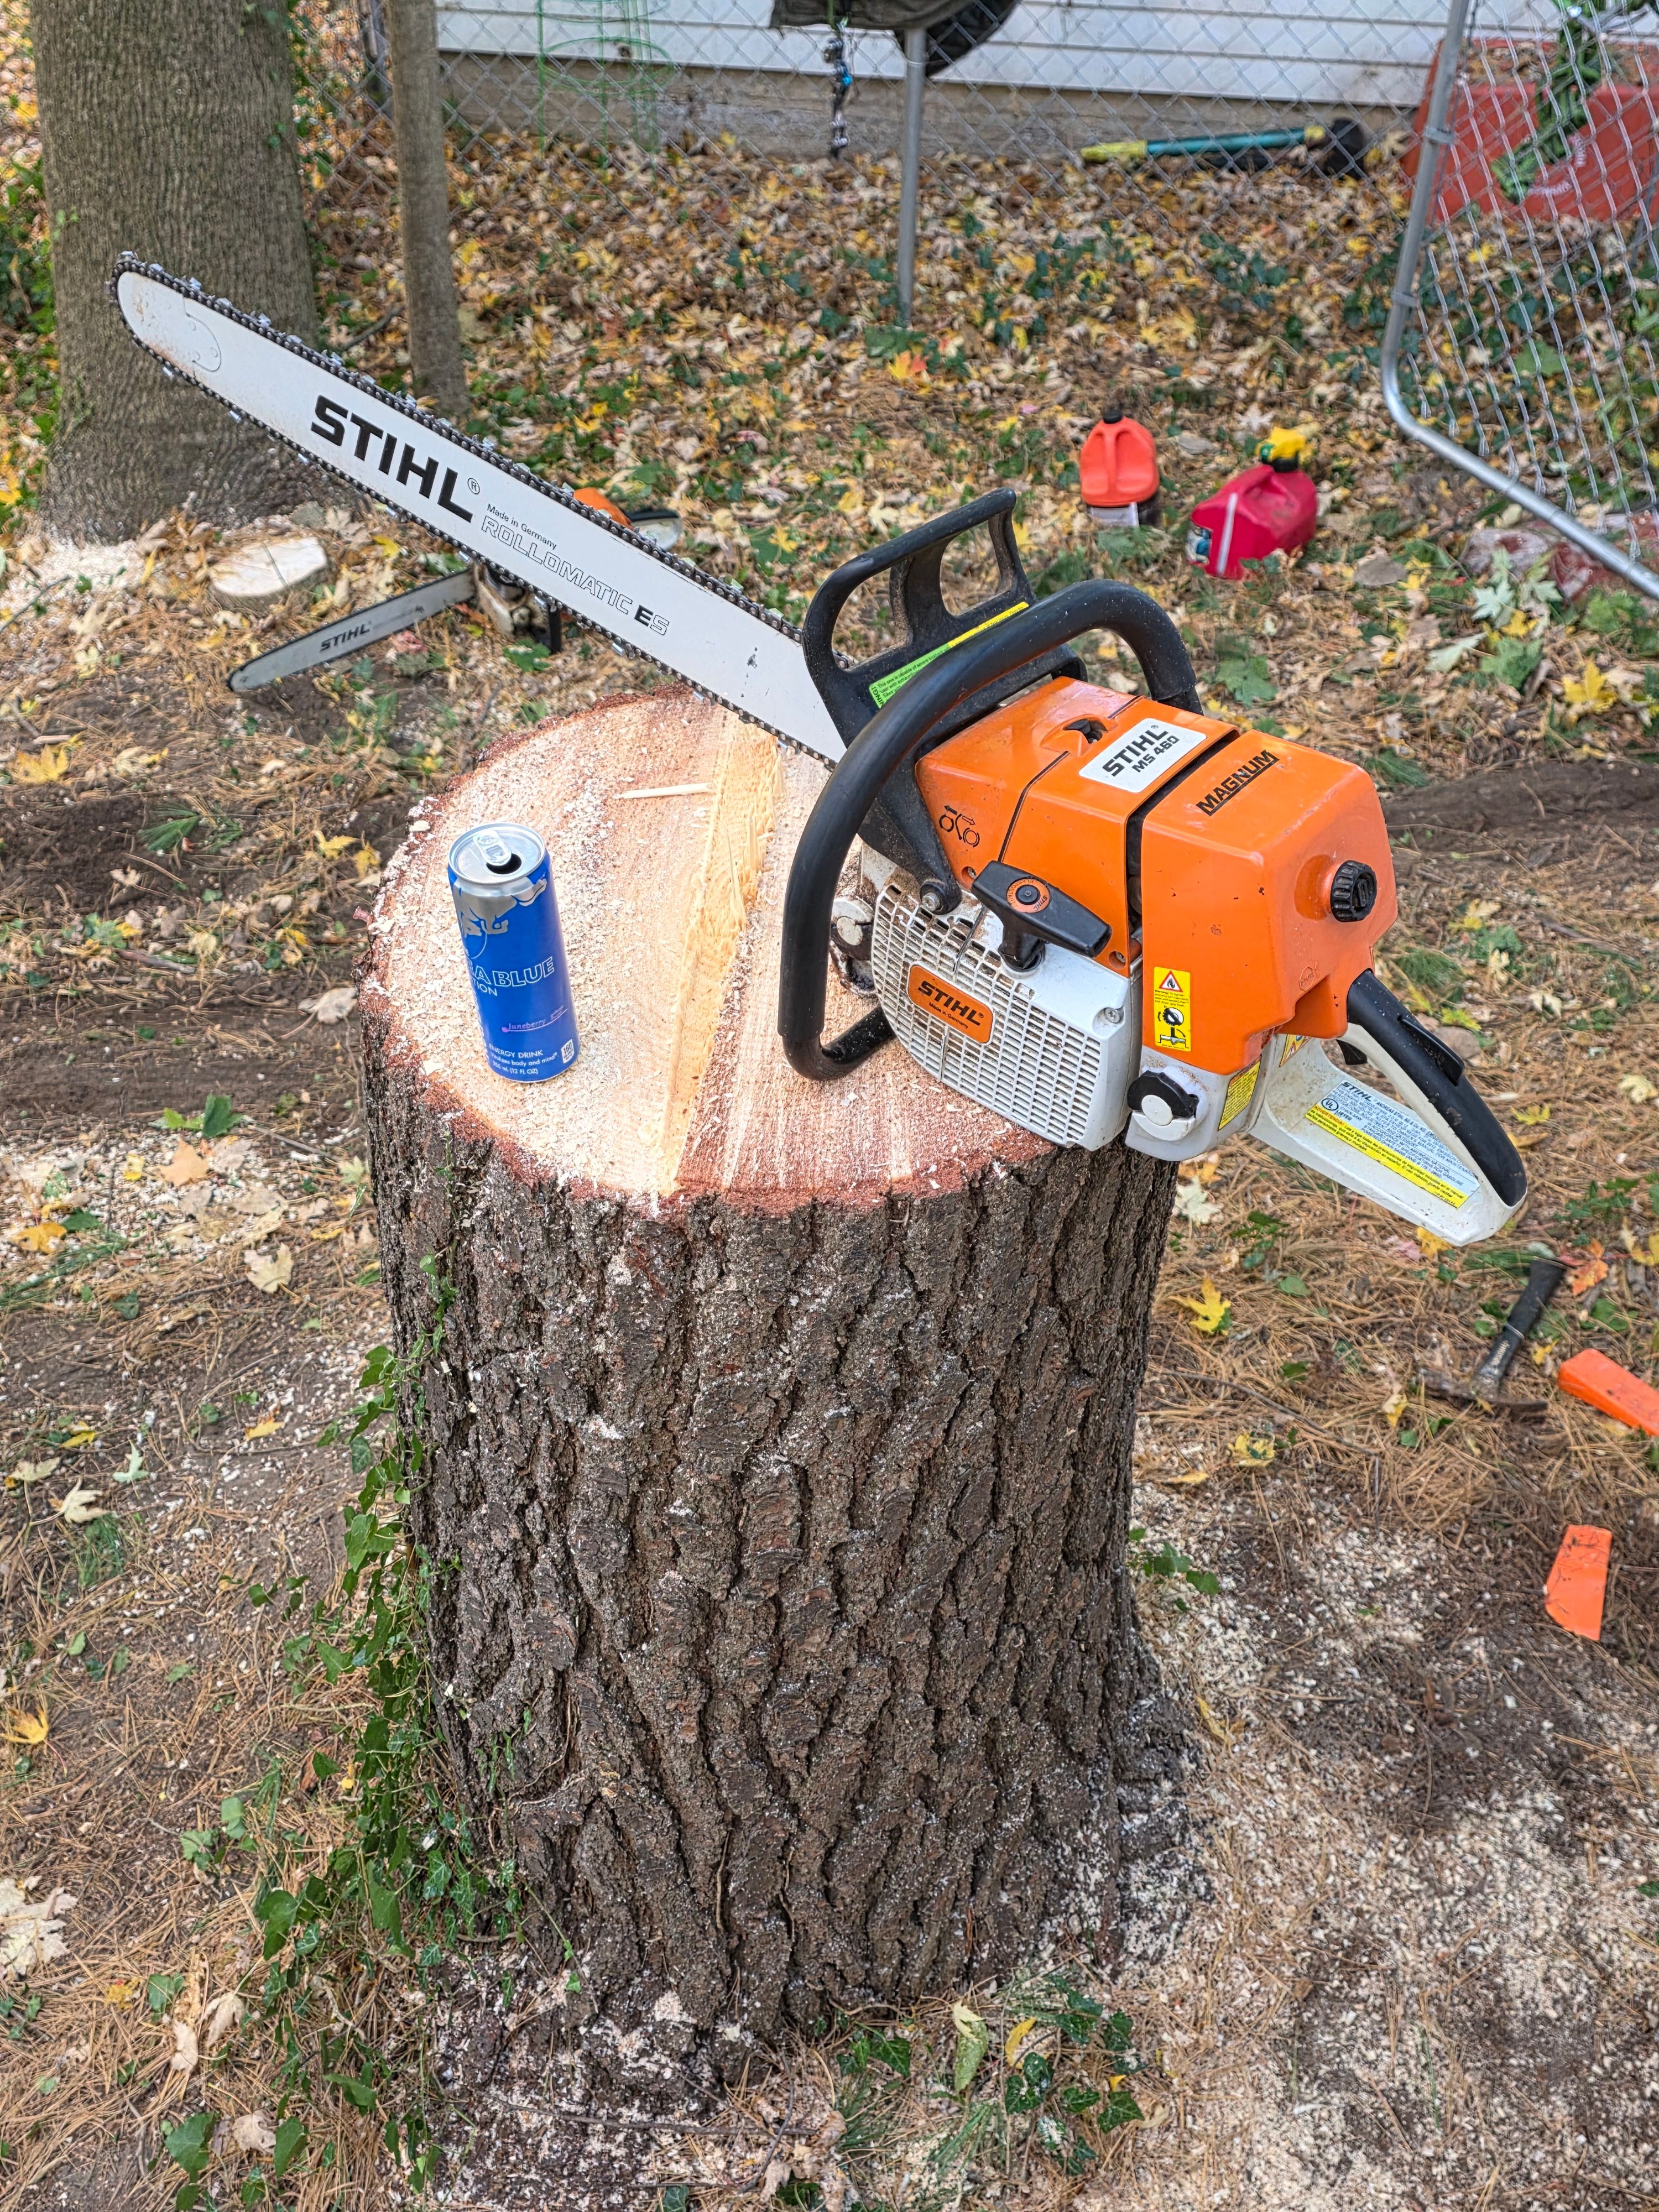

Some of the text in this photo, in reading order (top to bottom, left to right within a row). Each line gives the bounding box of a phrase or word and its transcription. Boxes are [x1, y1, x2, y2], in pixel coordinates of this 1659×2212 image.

[487, 504, 509, 522] Made
[521, 523, 557, 550] Germany
[481, 515, 670, 635] ROLLOMATIC ES
[1131, 735, 1180, 773] MS 460
[1196, 749, 1280, 817] MAGNUM
[1033, 895, 1048, 911] STIHL
[468, 956, 555, 987] EA BLUE
[508, 1018, 546, 1030] Juneberry
[929, 1002, 941, 1013] Made
[947, 1013, 968, 1029] Germany
[489, 1044, 543, 1058] ENERGY DRINK
[564, 1042, 572, 1054] 160
[1323, 1099, 1336, 1108] UL
[1340, 1080, 1374, 1102] STIHL
[1375, 1100, 1395, 1113] ANDREAS
[1343, 1092, 1360, 1103] ENGINE
[1317, 1119, 1337, 1132] personales
[1335, 1109, 1353, 1120] LISTED
[1360, 1127, 1382, 1141] POWERED
[1380, 1139, 1395, 1149] CHAIN
[1394, 1147, 1406, 1156] SAWS
[1363, 1124, 1386, 1139] STANDARD
[1384, 1138, 1401, 1149] SAFETY
[1400, 1146, 1434, 1168] SPECIFICATIONS
[1442, 1172, 1464, 1186] GASOLINE
[1371, 1124, 1400, 1142] ACCORDANCE
[1399, 1141, 1411, 1149] WITH
[1409, 1147, 1432, 1161] AMERICAN
[1430, 1160, 1451, 1173] NATIONAL
[1417, 1141, 1436, 1153] MANUAL
[1361, 1141, 1383, 1155] disposición
[1427, 1181, 1441, 1190] puede
[1439, 1188, 1453, 1198] causar
[1378, 1146, 1402, 1162] precauciones
[1406, 1163, 1425, 1176] seguridad
[1449, 1189, 1464, 1199] manual
